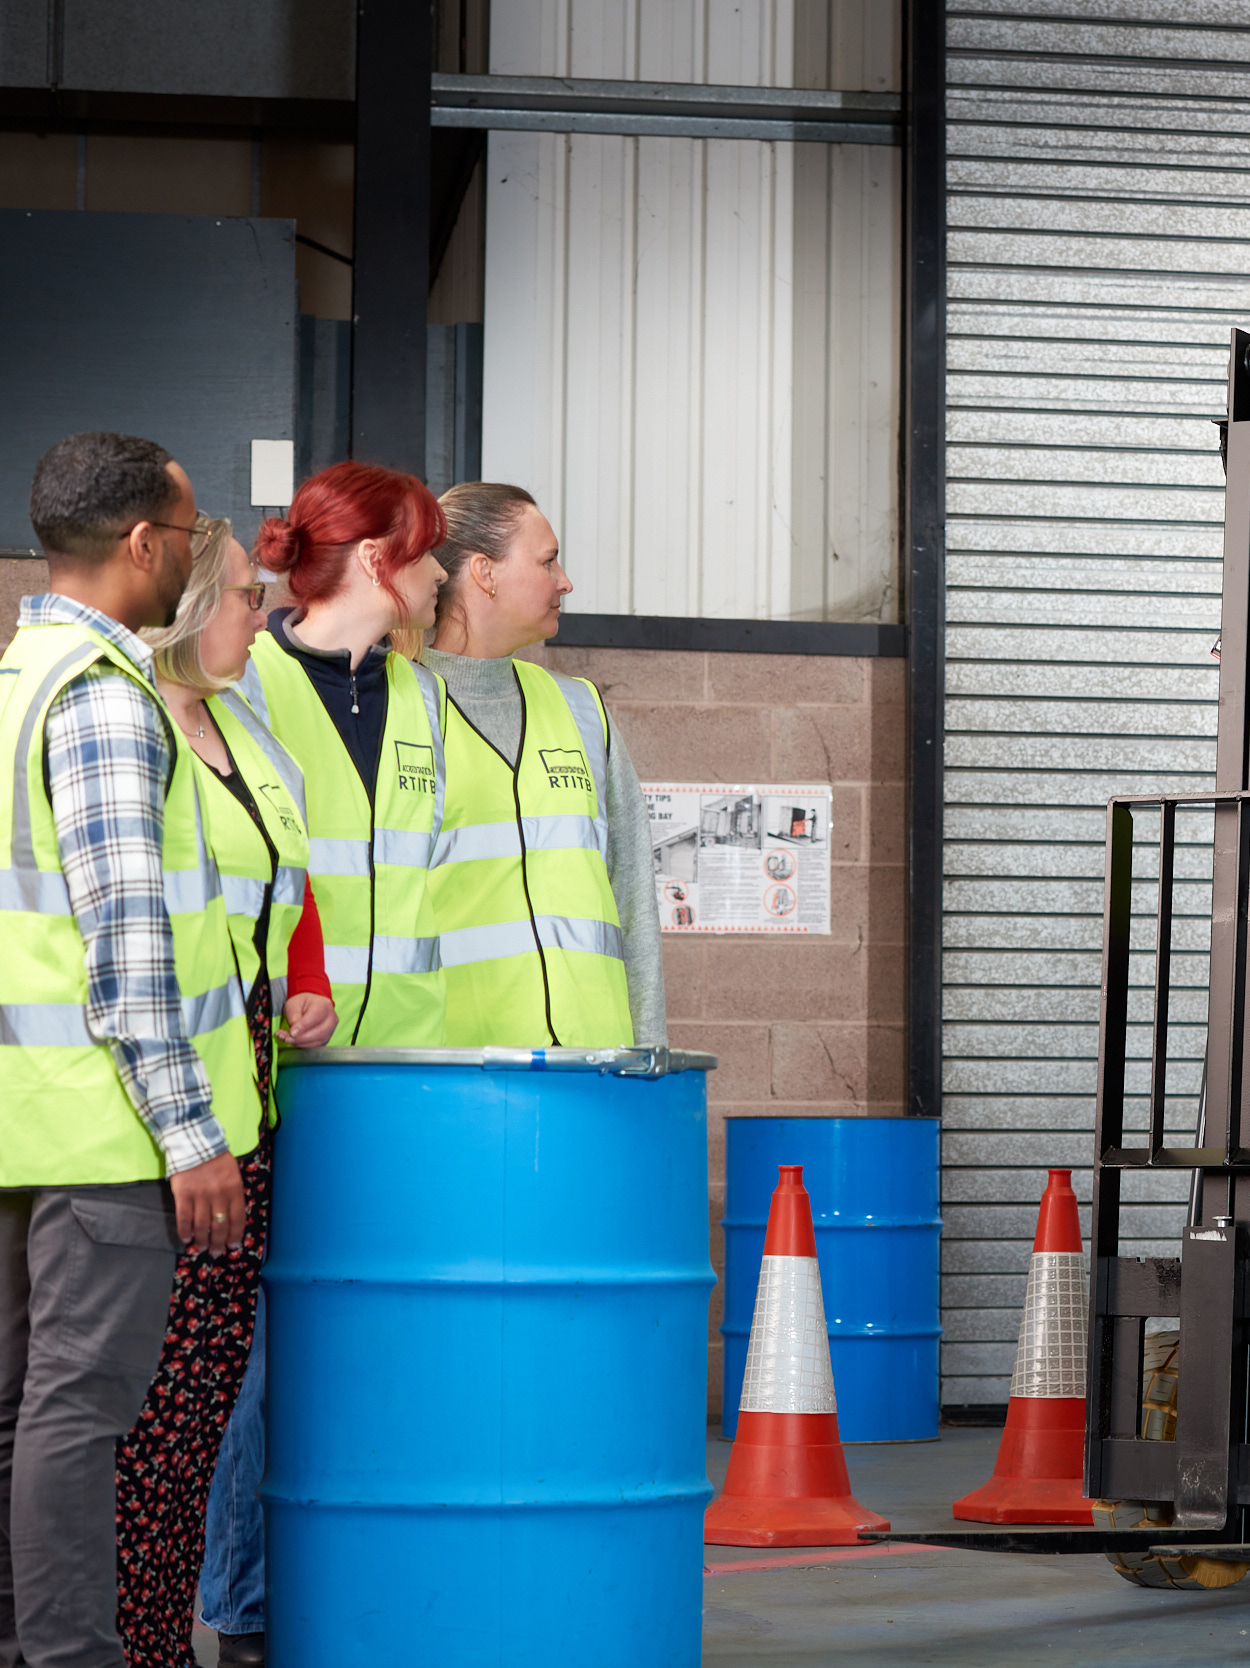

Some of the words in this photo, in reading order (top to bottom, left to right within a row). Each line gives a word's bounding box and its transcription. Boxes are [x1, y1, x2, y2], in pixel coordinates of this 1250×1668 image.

[398, 774, 436, 794] RTITB
[548, 775, 592, 792] RTITB
[655, 794, 672, 803] TIPS
[658, 812, 673, 820] BAY
